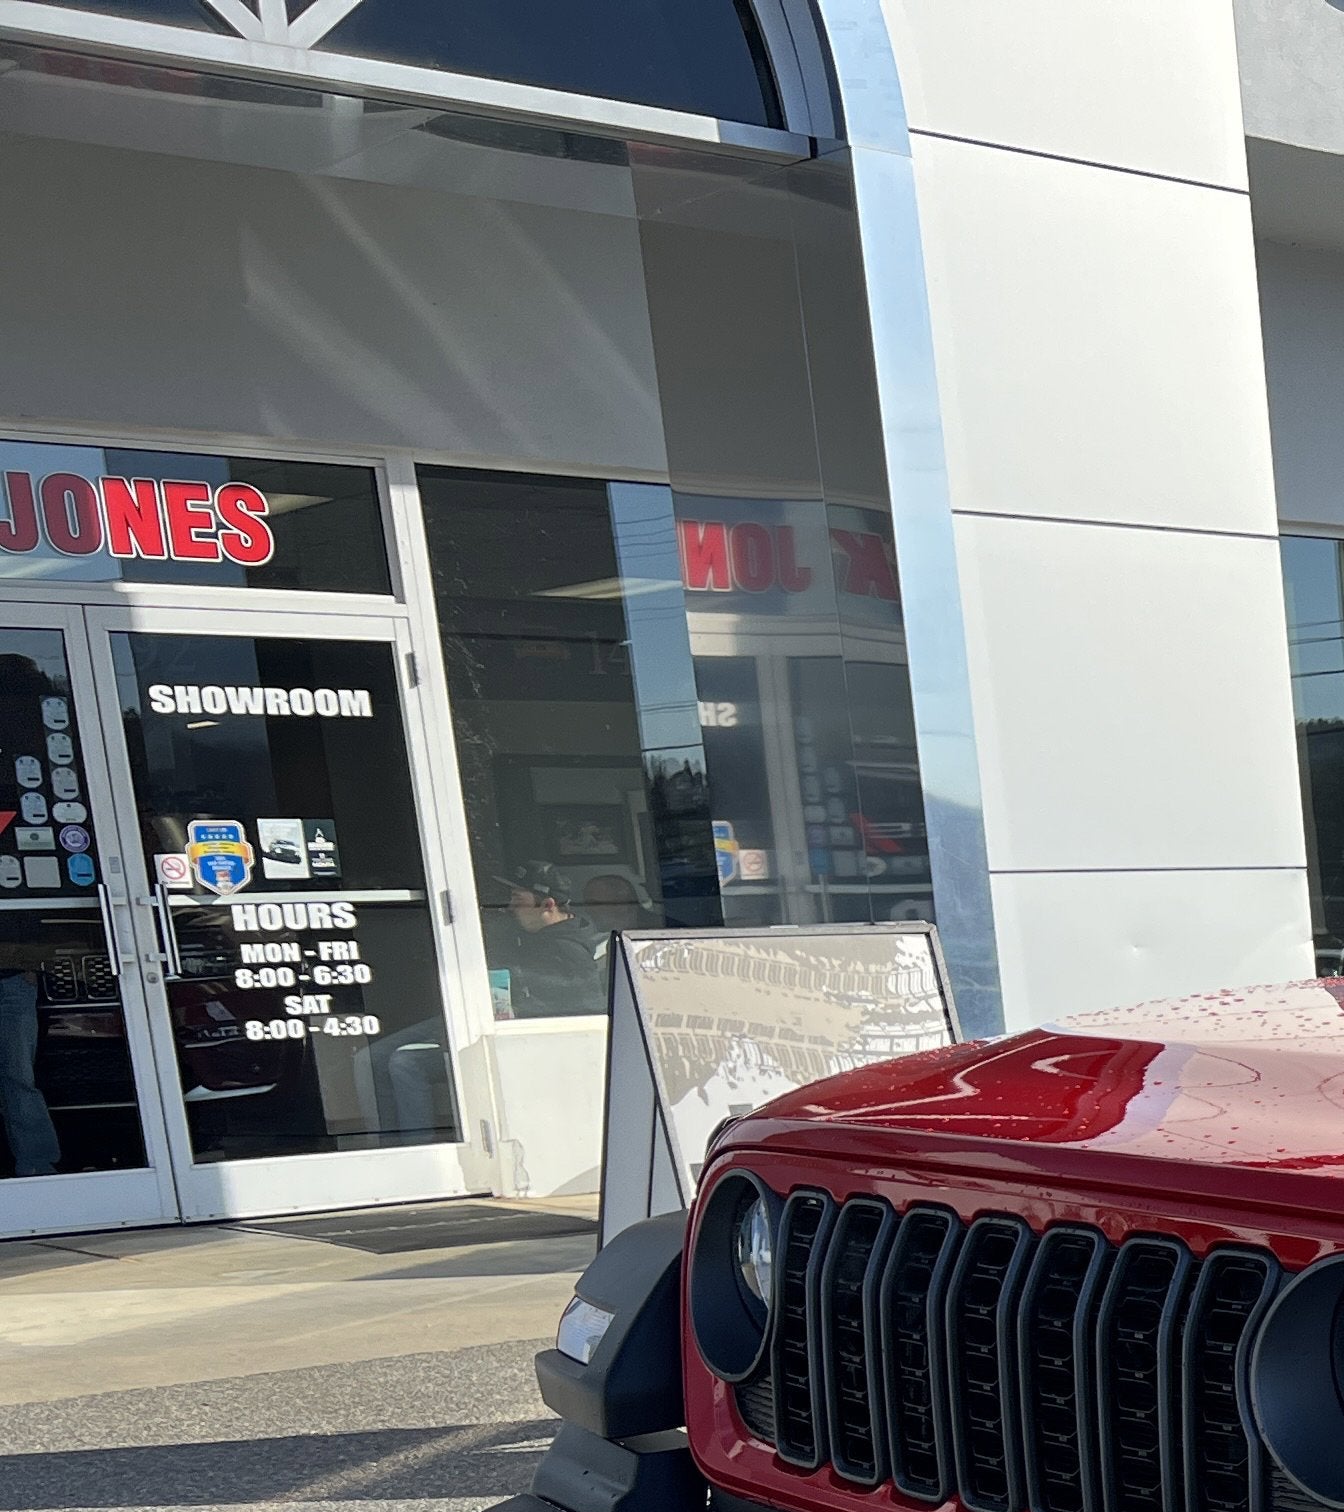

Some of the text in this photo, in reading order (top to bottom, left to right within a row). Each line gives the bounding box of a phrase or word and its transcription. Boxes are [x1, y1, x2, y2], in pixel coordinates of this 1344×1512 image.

[0, 470, 275, 567] JONES
[148, 684, 374, 718] SHOWROOM
[230, 902, 358, 932] HOURS
[239, 942, 302, 964] MON
[317, 940, 361, 961] FRI
[234, 967, 296, 989] 8:00
[313, 963, 373, 986] 6:30
[284, 994, 334, 1016] SAT
[245, 1018, 306, 1041] 8:00
[323, 1015, 381, 1037] 4:30
